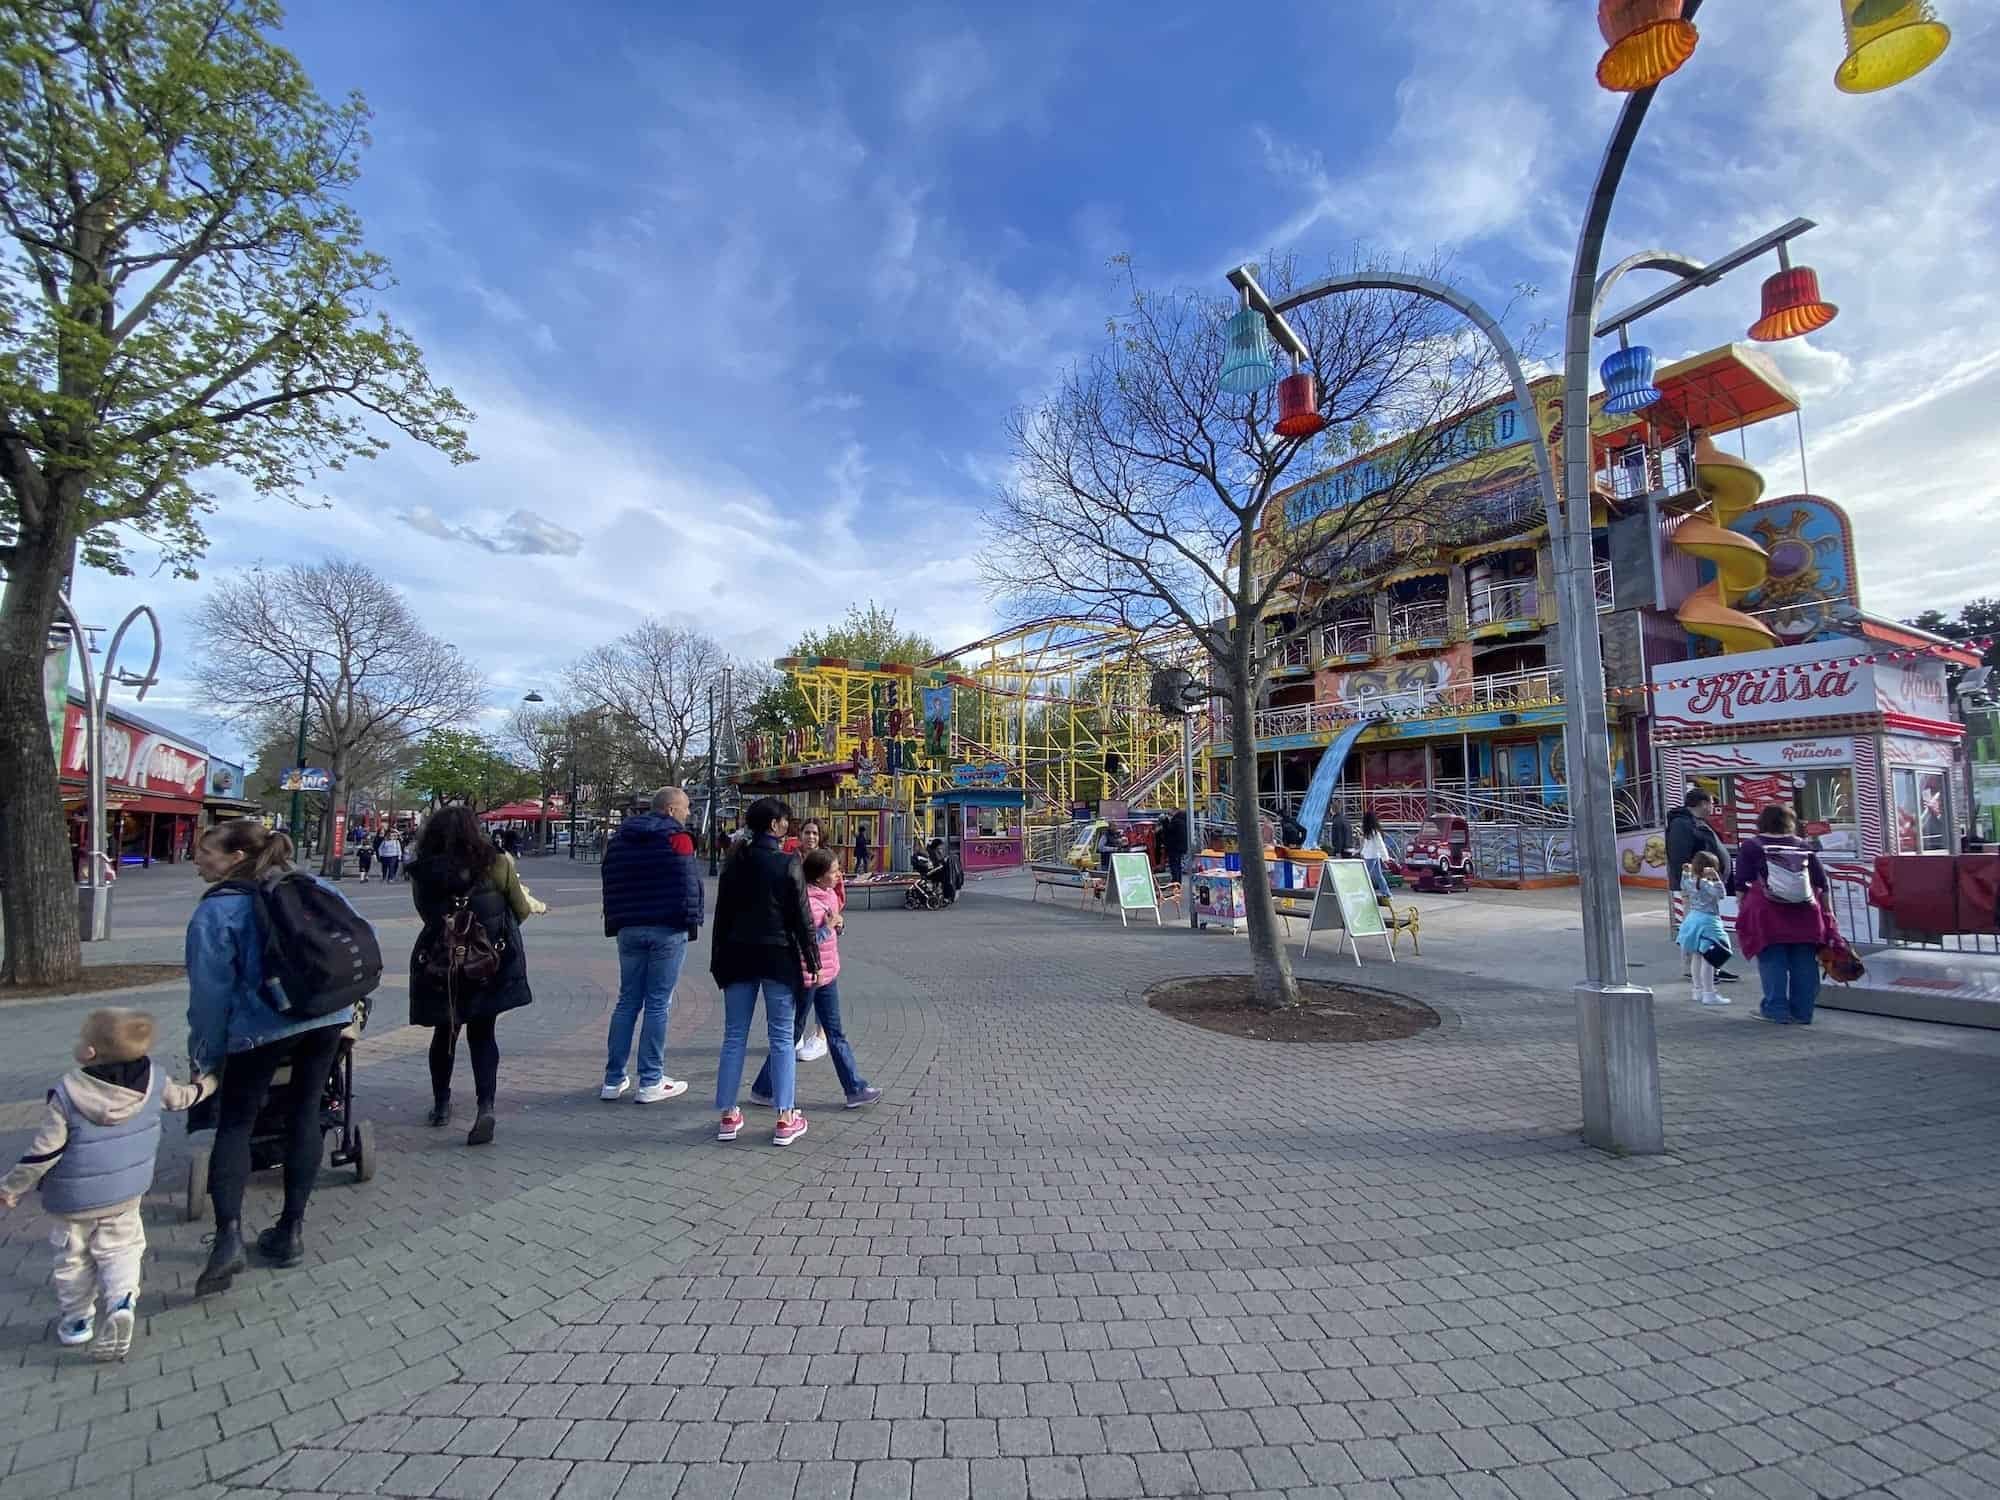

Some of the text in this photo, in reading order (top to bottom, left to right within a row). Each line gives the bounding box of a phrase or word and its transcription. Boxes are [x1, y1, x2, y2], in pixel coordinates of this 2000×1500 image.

[1687, 670, 1858, 719] Kassa
[1782, 746, 1843, 762] Rutsche
[302, 776, 329, 789] WC
